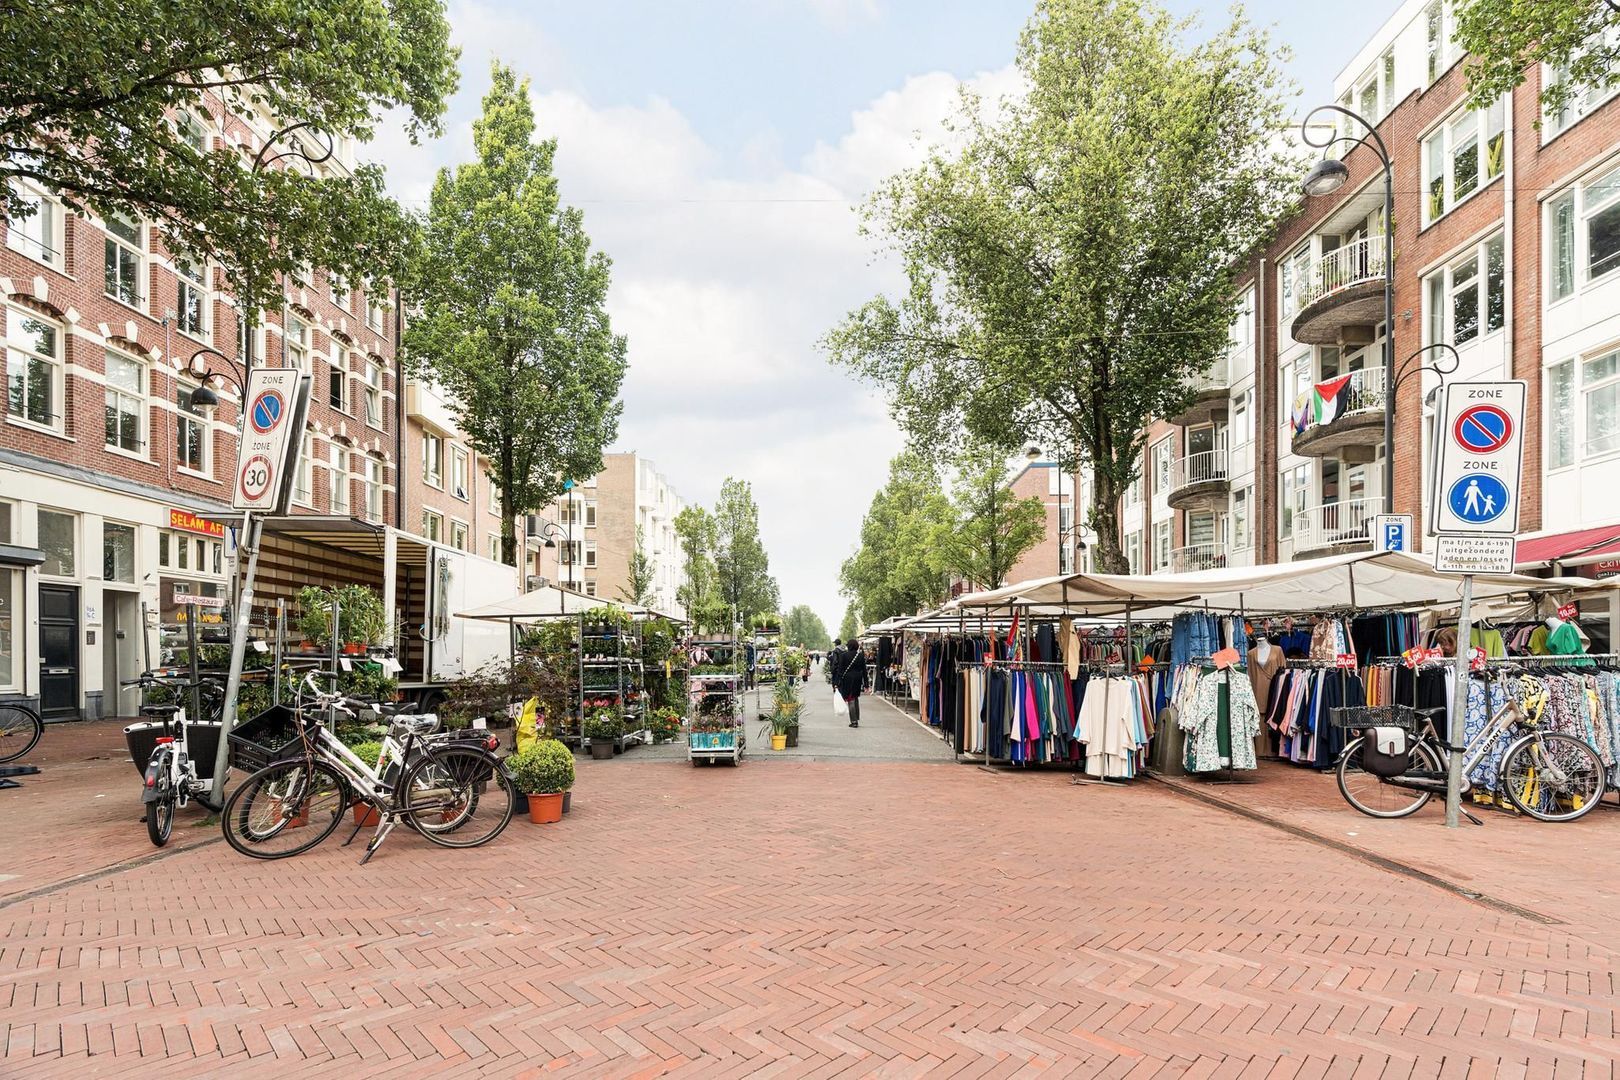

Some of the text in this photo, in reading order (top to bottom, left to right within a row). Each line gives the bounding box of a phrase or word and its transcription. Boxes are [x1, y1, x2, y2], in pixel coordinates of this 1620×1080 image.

[262, 376, 284, 384] ZONE
[1468, 390, 1503, 398] ZONE
[252, 442, 270, 450] ZONE
[1463, 461, 1498, 470] ZONE
[246, 469, 267, 487] 30
[171, 512, 205, 531] SELAM
[1388, 526, 1400, 540] P
[1482, 729, 1502, 752] GIANT
